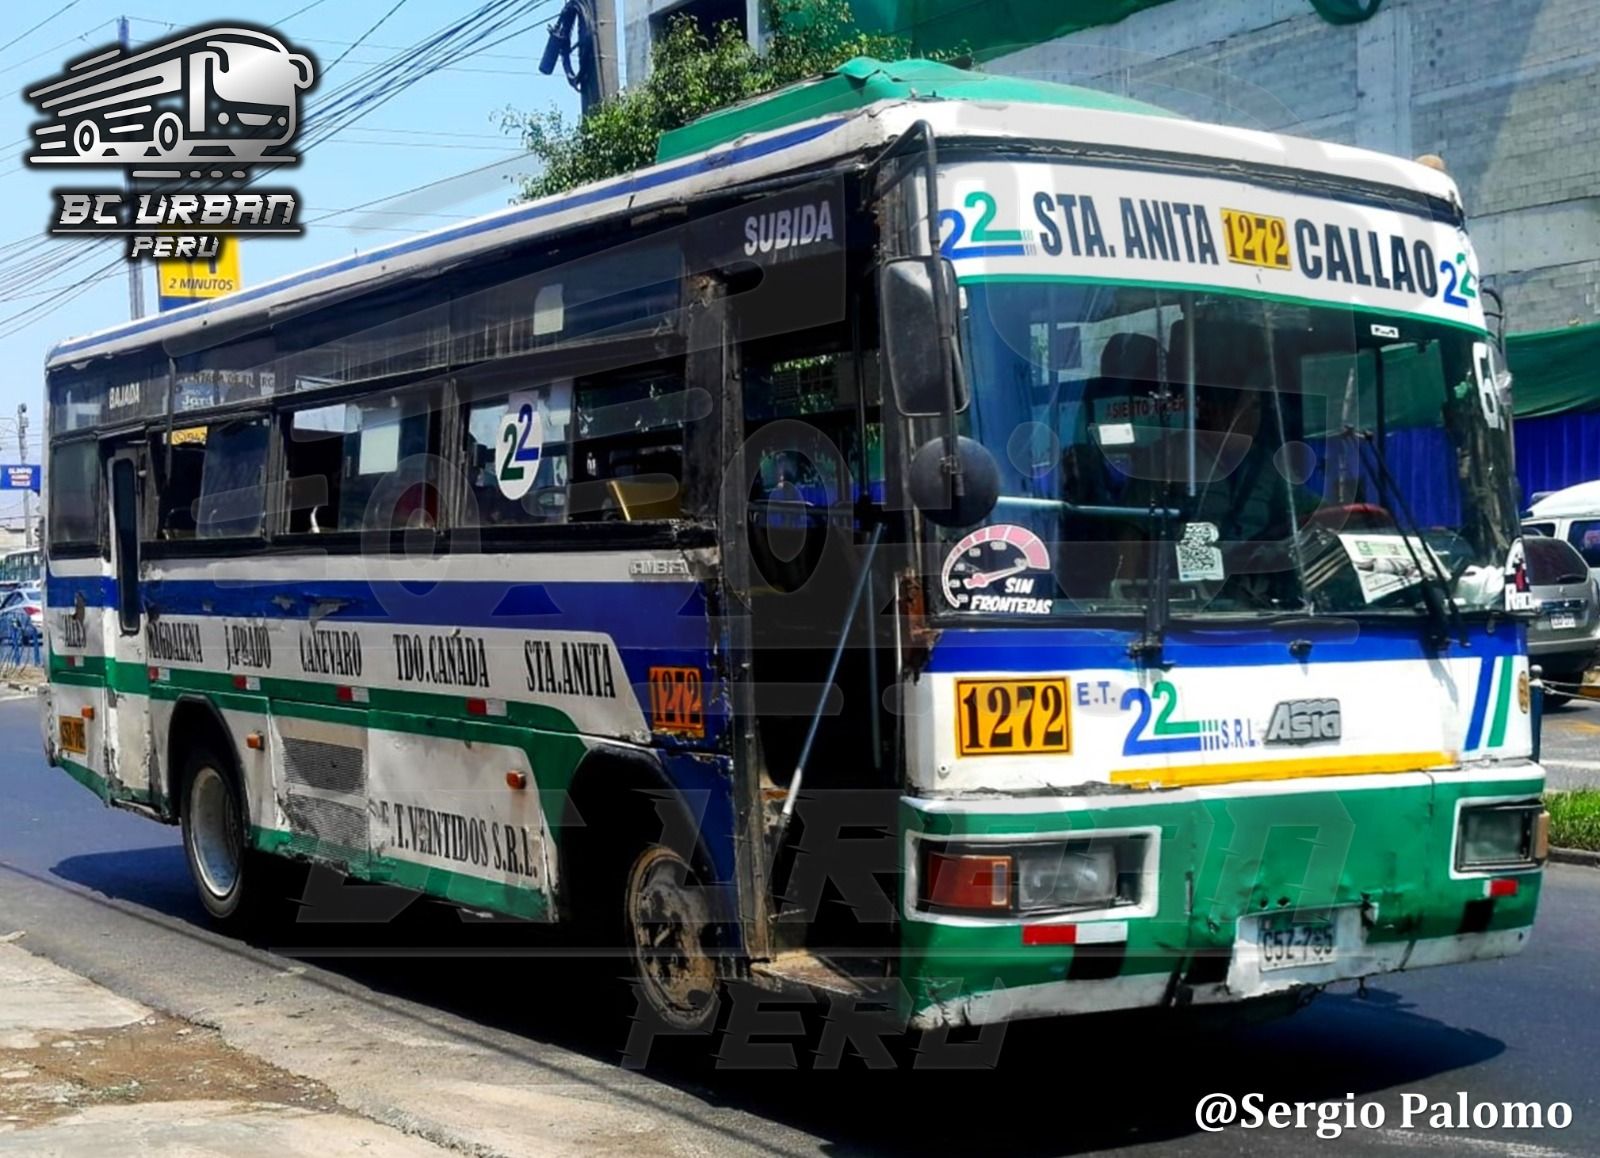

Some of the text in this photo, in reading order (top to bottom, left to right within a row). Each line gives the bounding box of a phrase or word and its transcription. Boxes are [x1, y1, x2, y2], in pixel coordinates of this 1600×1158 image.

[744, 200, 833, 256] SUBIDA
[938, 191, 1477, 308] 22 STA. ANITA 1272 CALLAO 22
[168, 278, 233, 291] 2 MINUTOS
[500, 403, 540, 481] 22
[970, 595, 1053, 615] FRONTERAS
[1004, 577, 1034, 595] SIN
[524, 639, 616, 698] STA.ANITA
[652, 670, 702, 724] 1272
[963, 684, 1064, 749] 1272
[1076, 681, 1117, 706] E.T.
[1119, 681, 1200, 756] 22
[1266, 699, 1341, 744] Asia
